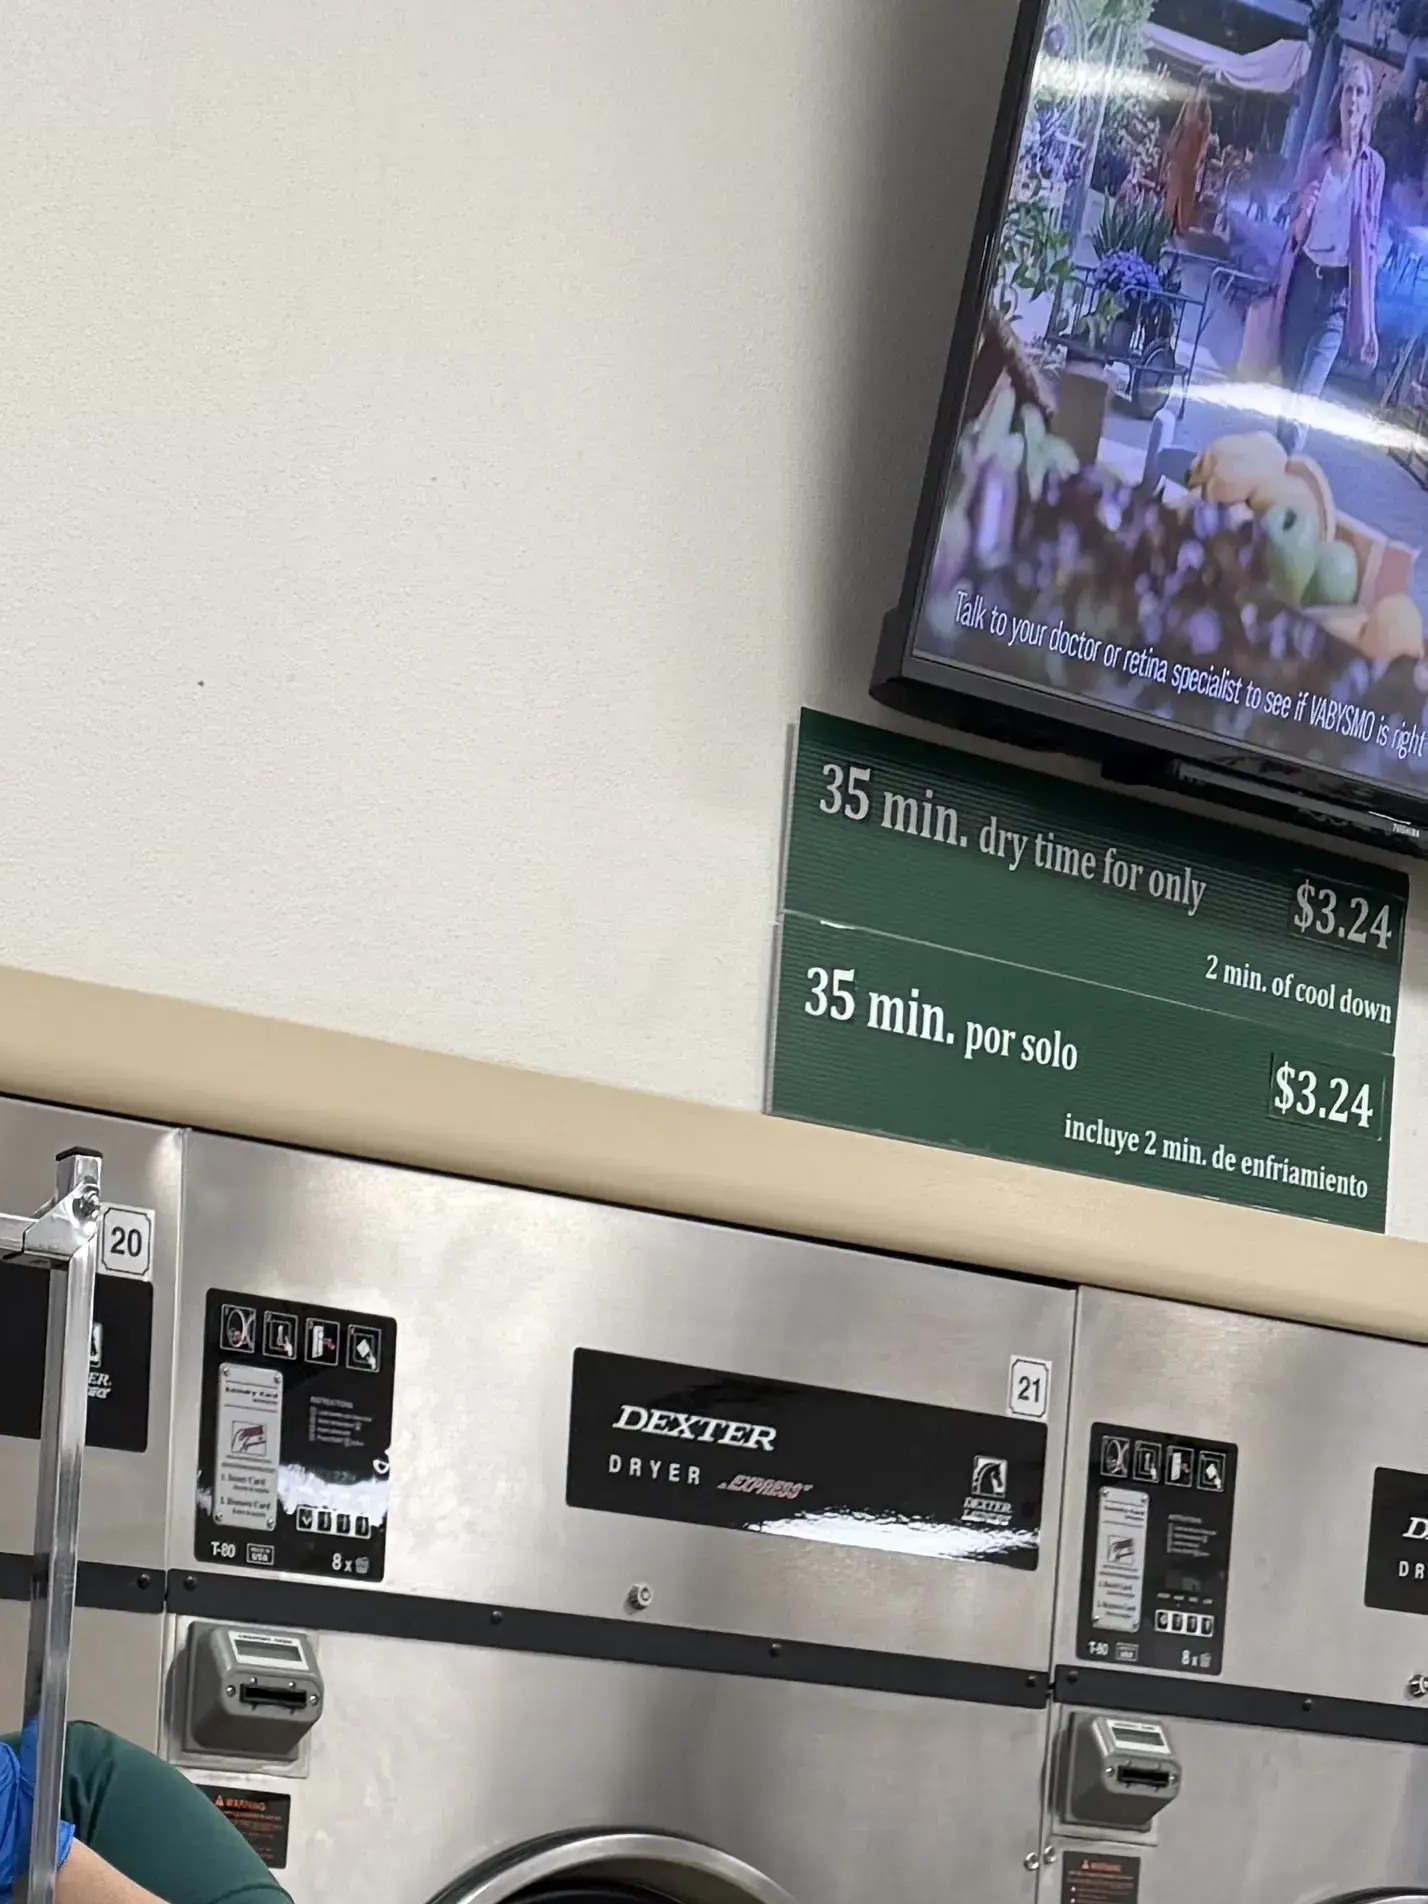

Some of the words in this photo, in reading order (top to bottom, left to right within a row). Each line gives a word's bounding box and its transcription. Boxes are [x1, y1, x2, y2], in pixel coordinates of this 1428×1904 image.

[955, 590, 986, 629] Talk
[990, 605, 1008, 636] to
[1008, 617, 1048, 646] your
[1049, 620, 1102, 662] doctor
[1103, 643, 1122, 668] or
[1123, 647, 1168, 684] retina
[1171, 662, 1242, 704] specialist
[1245, 680, 1261, 709] to
[1264, 691, 1292, 718] see
[1294, 691, 1309, 721] if
[1309, 695, 1375, 742] VABYSMO
[1376, 716, 1389, 747] is
[1391, 721, 1425, 759] right
[818, 762, 872, 822] 35
[881, 788, 969, 848] min.
[978, 816, 1029, 872] dry
[1033, 829, 1096, 882] time
[1102, 846, 1144, 893] for
[1148, 866, 1207, 917] only
[1293, 878, 1393, 950] $3.24
[1204, 954, 1218, 981] 2
[1222, 960, 1268, 994] min.
[1271, 971, 1294, 1000] of
[1294, 977, 1337, 1012] cool
[1339, 987, 1393, 1025] down
[804, 966, 856, 1022] 35
[867, 988, 955, 1045] min.
[964, 1018, 1016, 1061] por
[1020, 1029, 1078, 1072] solo
[1273, 1061, 1374, 1129] $3.24
[1064, 1113, 1140, 1155] incluye
[1143, 1129, 1157, 1156] 2
[1161, 1137, 1207, 1170] min.
[1211, 1144, 1237, 1174] de
[1240, 1153, 1369, 1200] enfriamiento
[110, 1226, 143, 1257] 20
[1017, 1375, 1041, 1402] 21
[611, 1404, 778, 1453] DEXTER
[607, 1454, 701, 1486] DRYER
[730, 1474, 801, 1500] EXPRESS
[211, 1541, 236, 1558] T-80
[332, 1552, 342, 1571] 8
[1181, 1649, 1190, 1665] 8
